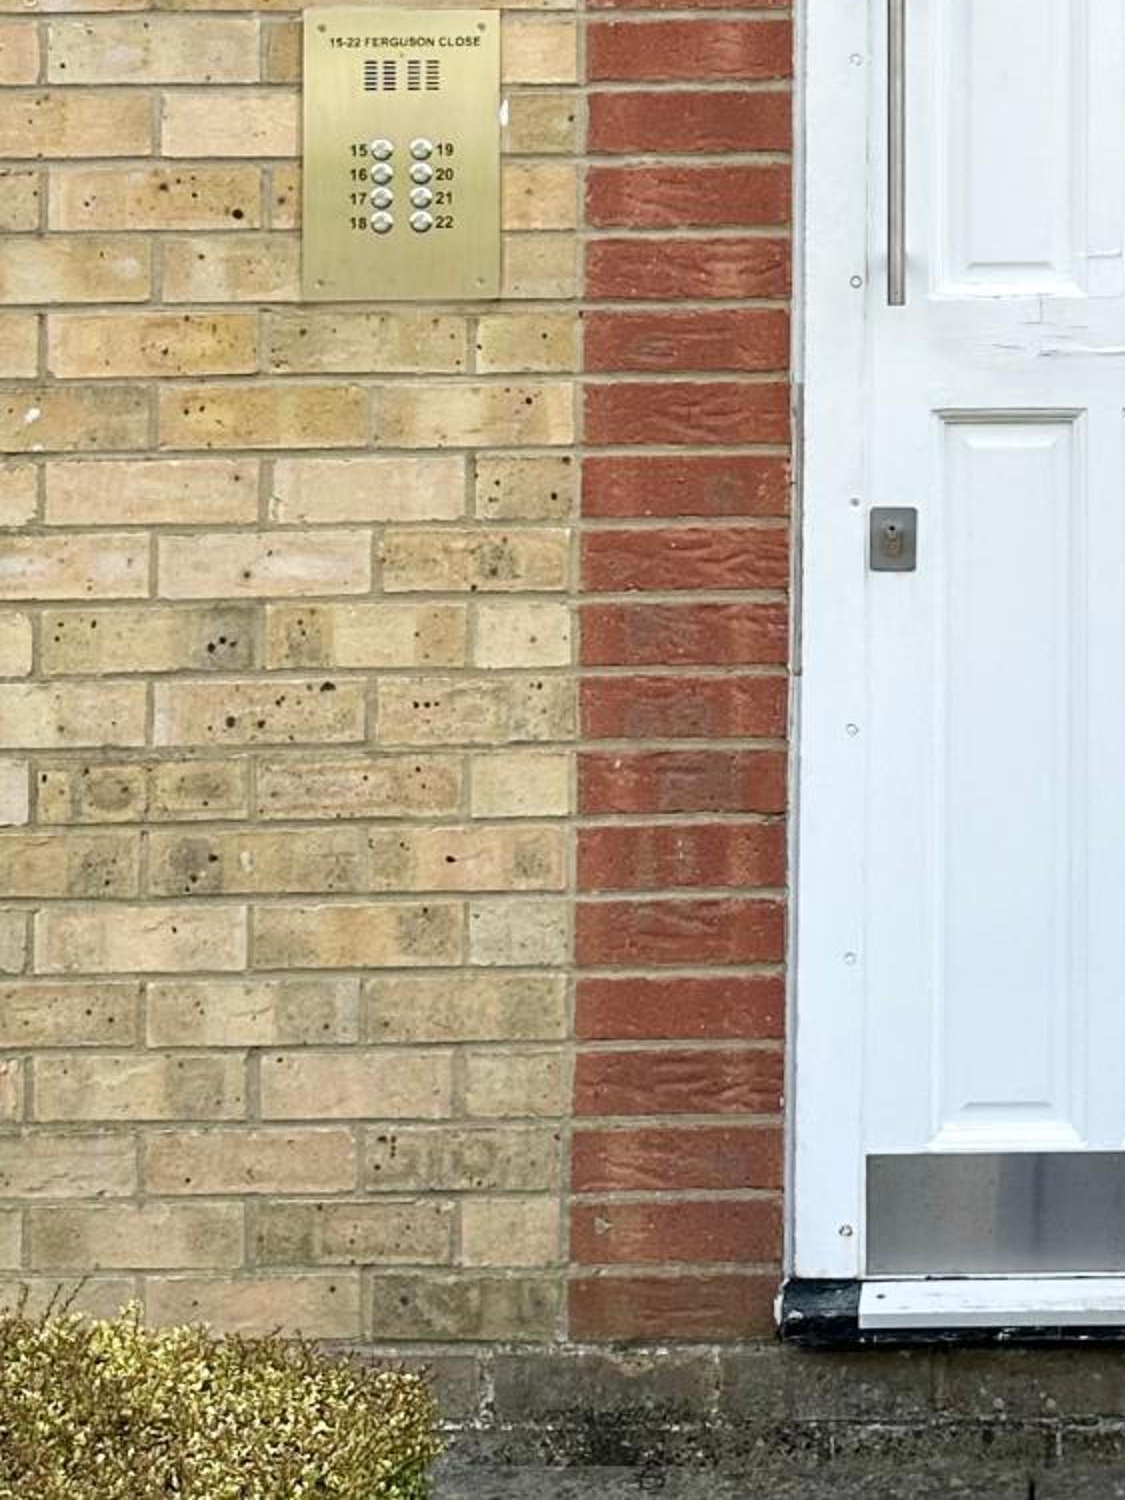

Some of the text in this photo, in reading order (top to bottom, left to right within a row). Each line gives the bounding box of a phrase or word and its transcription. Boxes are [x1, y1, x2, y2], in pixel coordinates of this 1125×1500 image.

[330, 35, 481, 49] 15-22 FERGUSON CLOSE
[350, 143, 369, 157] 15
[436, 143, 455, 157] 19
[350, 167, 368, 181] 16
[435, 167, 455, 181] 20
[349, 192, 368, 205] 17
[435, 191, 454, 205] 21
[350, 216, 368, 230] 18
[435, 215, 454, 229] 22
